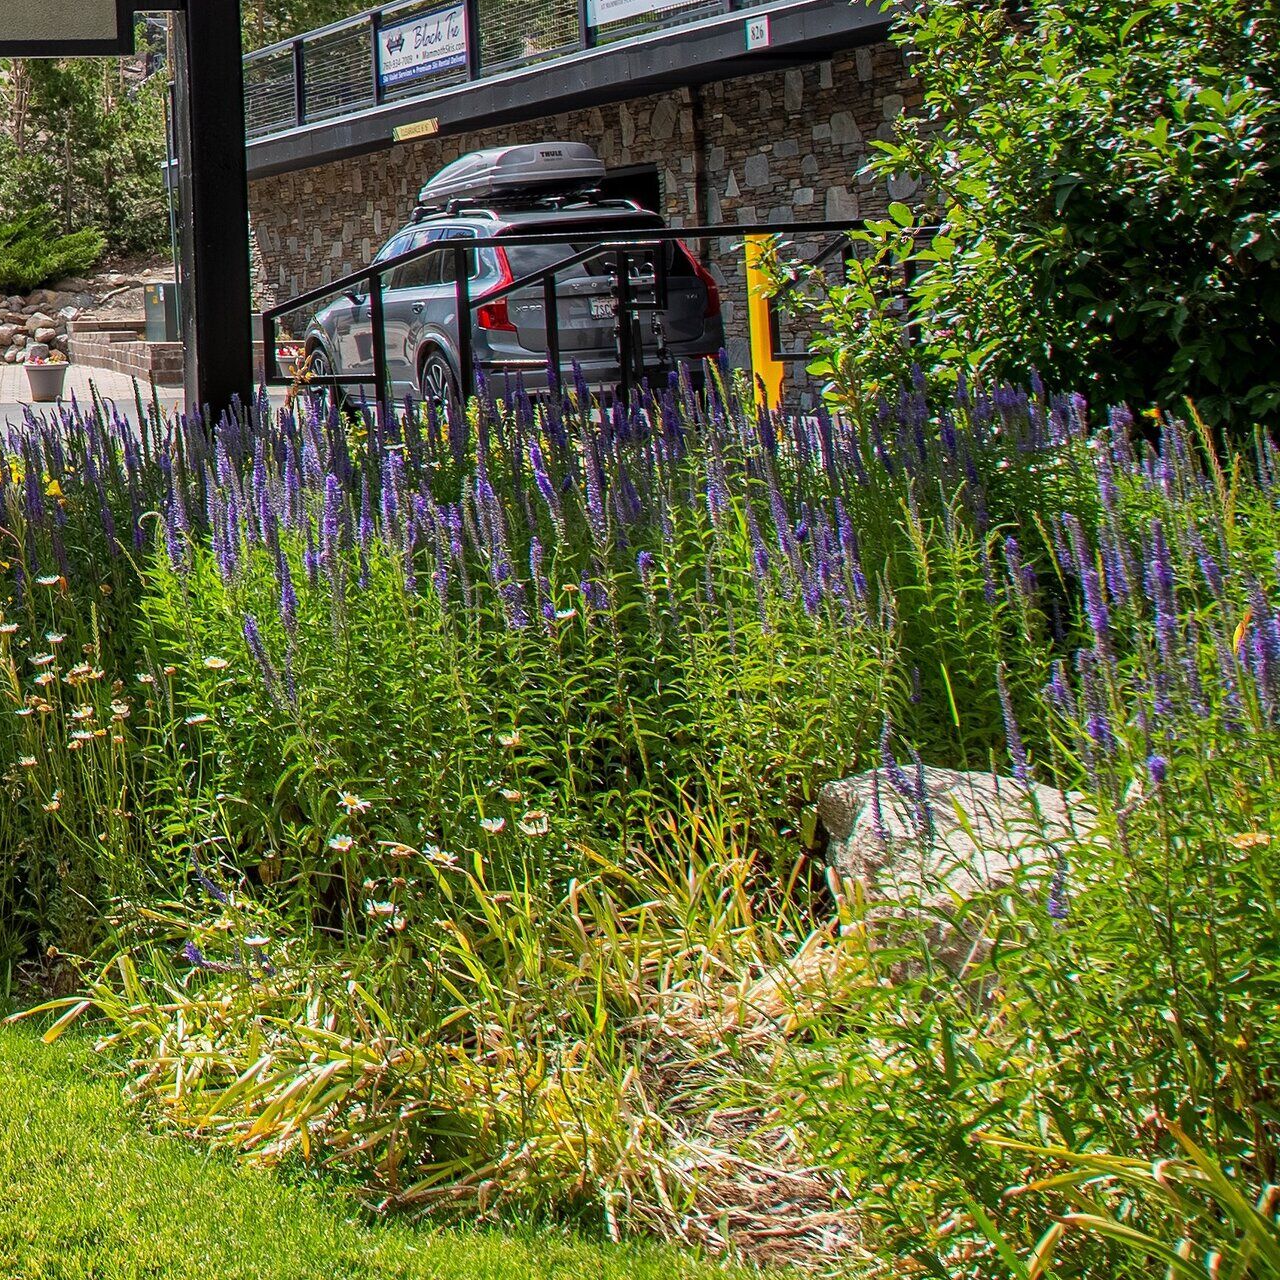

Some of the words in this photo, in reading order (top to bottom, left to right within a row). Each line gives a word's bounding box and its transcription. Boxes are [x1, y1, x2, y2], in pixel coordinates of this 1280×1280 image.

[412, 21, 442, 49] Black
[444, 11, 460, 40] Tie
[751, 24, 764, 40] 826
[540, 150, 562, 158] THULE
